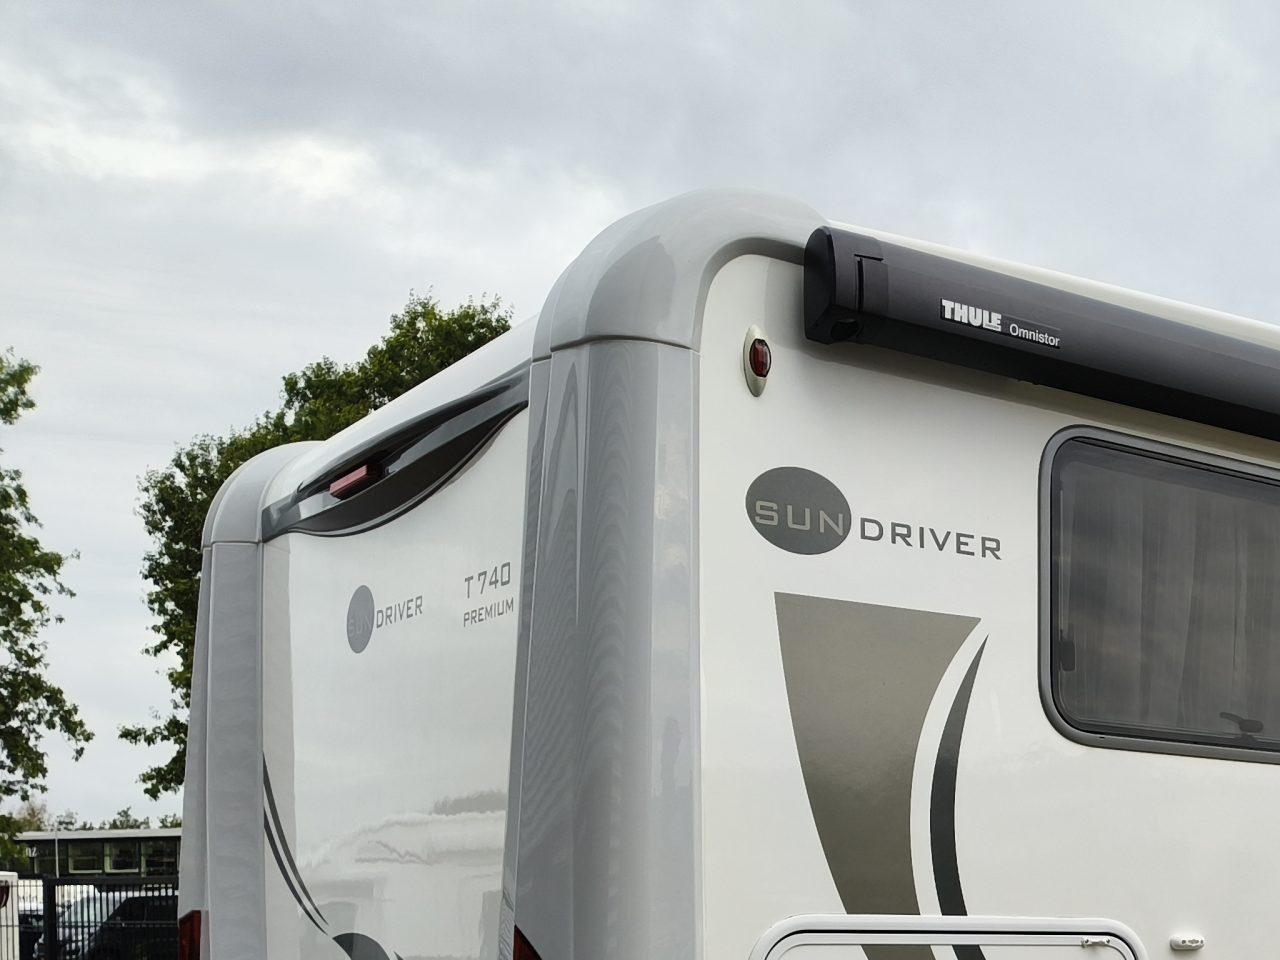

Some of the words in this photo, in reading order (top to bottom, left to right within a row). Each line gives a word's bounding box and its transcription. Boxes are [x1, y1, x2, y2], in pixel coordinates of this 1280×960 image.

[941, 298, 1002, 332] THULE
[1009, 323, 1061, 347] Omnistor
[755, 500, 844, 536] SUN
[860, 517, 1002, 560] DRIVER
[376, 595, 423, 629] DRIVER
[463, 597, 514, 628] PREMIUM
